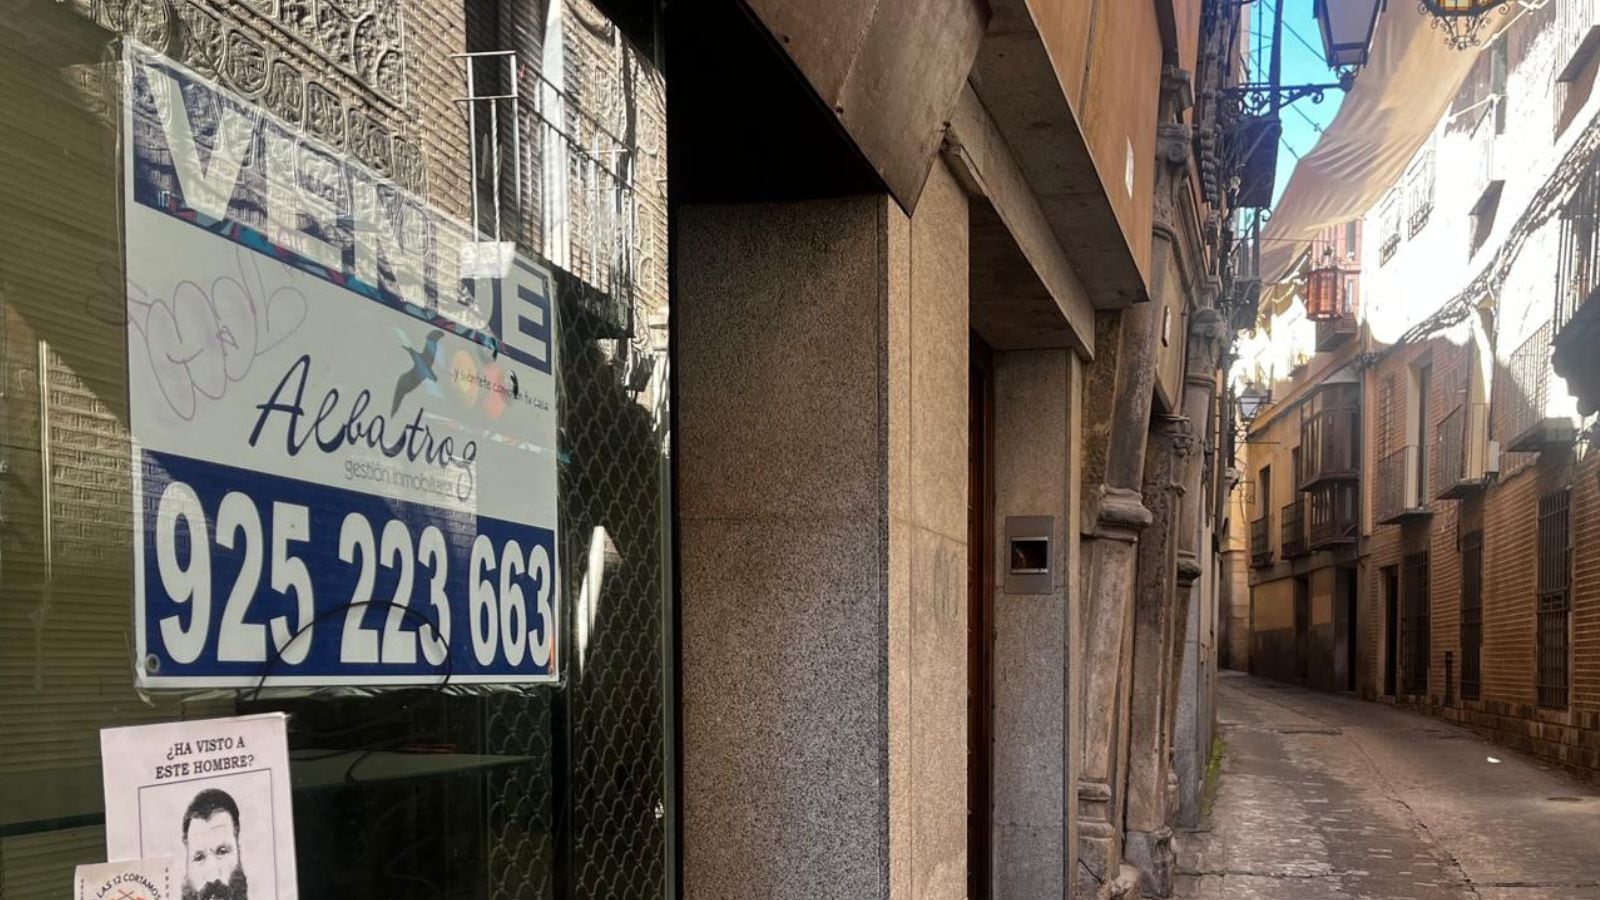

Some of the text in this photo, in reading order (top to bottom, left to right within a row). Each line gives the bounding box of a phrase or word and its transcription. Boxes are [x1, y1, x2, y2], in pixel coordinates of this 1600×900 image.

[144, 58, 548, 366] VENDE
[155, 481, 554, 667] 925 223 663
[166, 736, 245, 760] ¿HA VISTO A
[155, 754, 255, 780] ESTE HOMBRE?
[96, 881, 112, 898] LAS
[112, 875, 122, 885] 12
